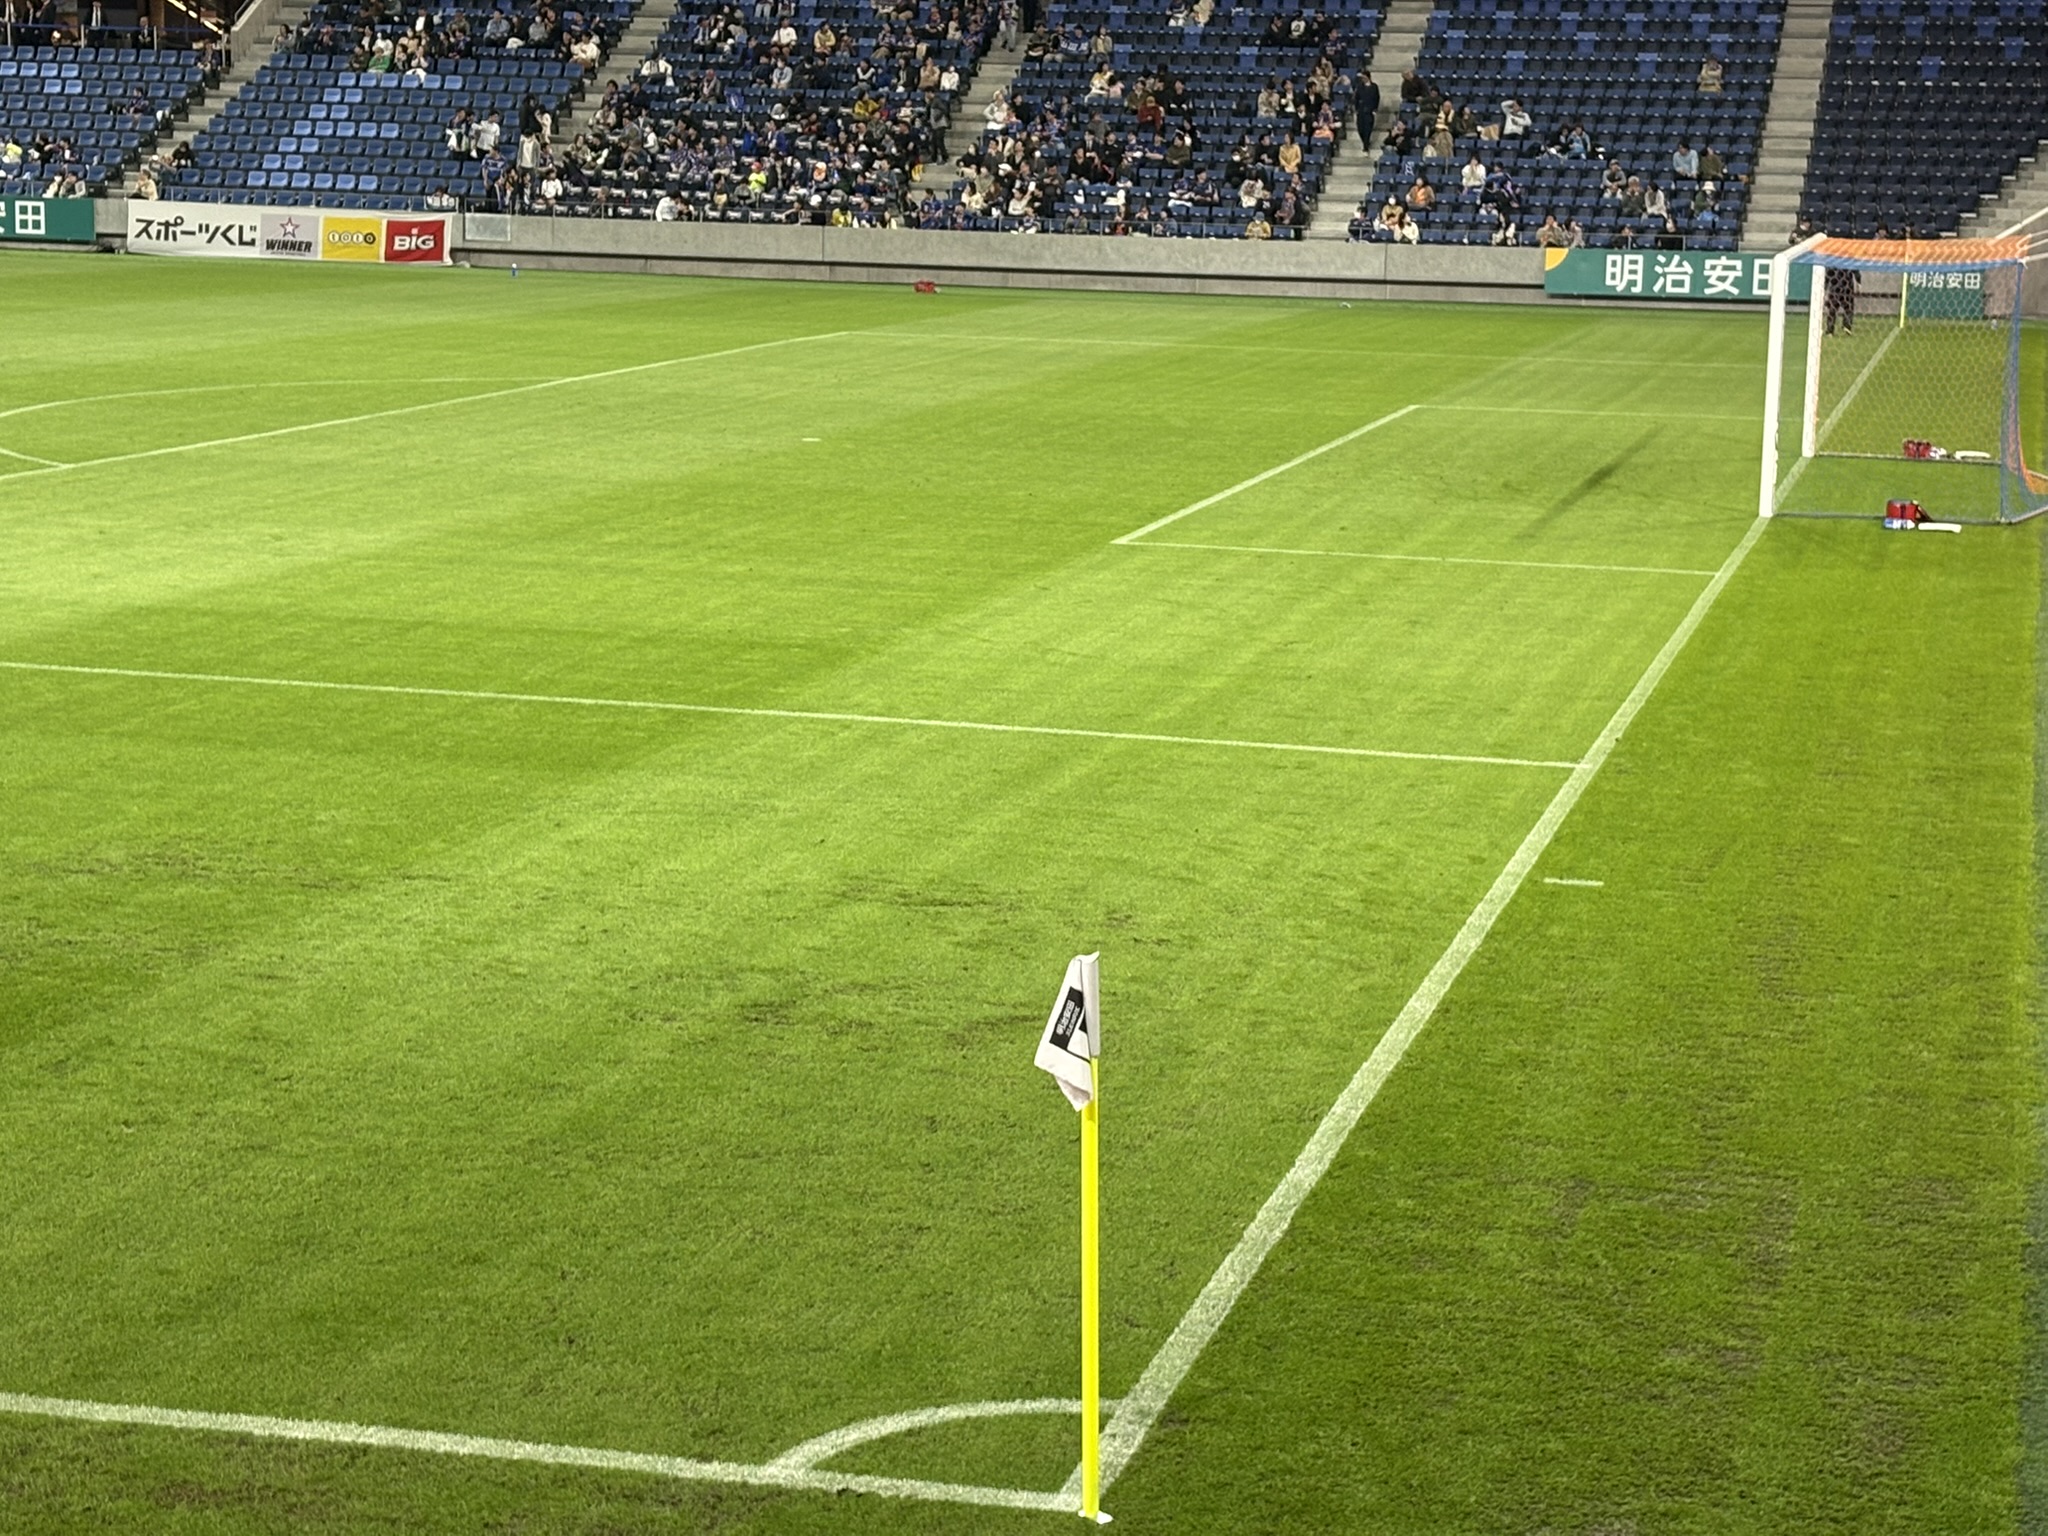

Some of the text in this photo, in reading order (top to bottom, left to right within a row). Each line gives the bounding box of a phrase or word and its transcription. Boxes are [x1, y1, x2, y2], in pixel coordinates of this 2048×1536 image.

[0, 200, 46, 235] 田
[134, 215, 257, 247] スポーツくじ
[329, 231, 376, 244] toto
[265, 239, 313, 253] WINNER
[1605, 254, 1789, 297] 明治安田
[1910, 272, 1981, 289] 明治安田
